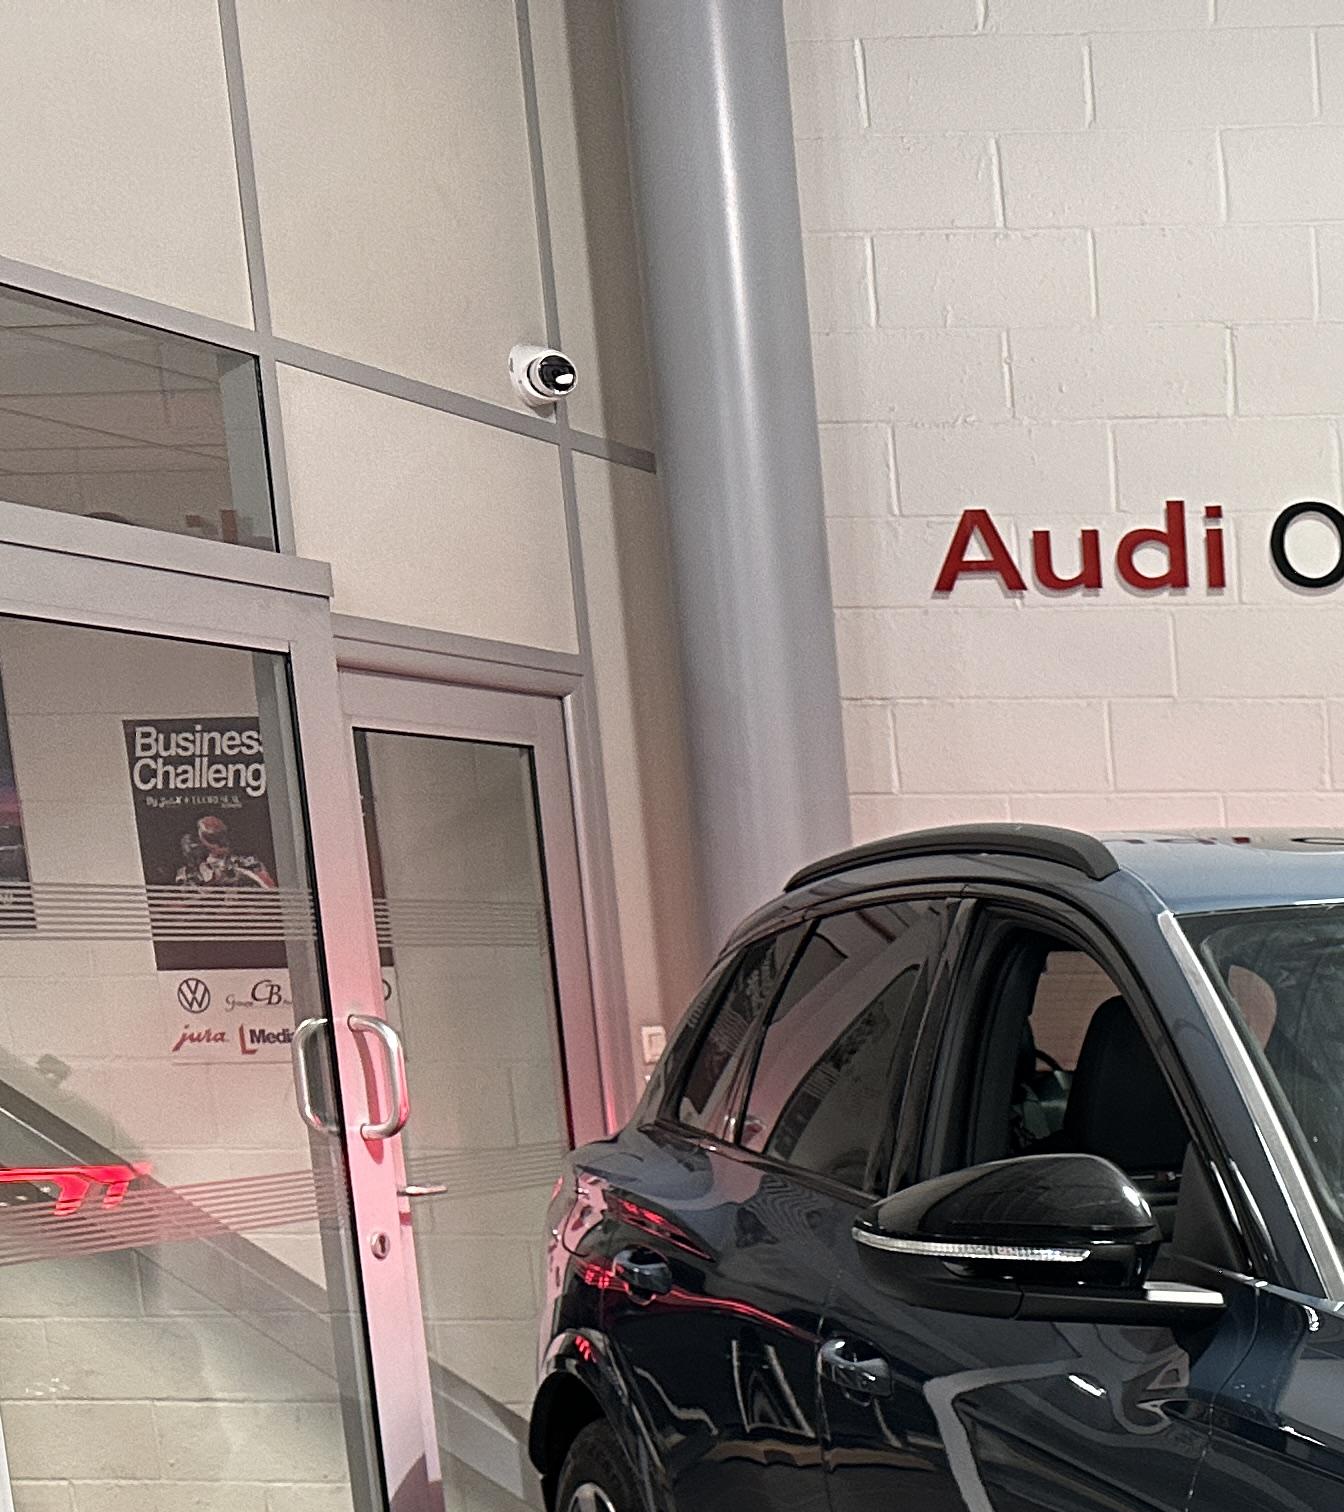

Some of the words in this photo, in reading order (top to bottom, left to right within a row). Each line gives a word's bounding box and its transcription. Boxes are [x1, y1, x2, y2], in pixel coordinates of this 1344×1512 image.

[935, 501, 1226, 592] Audi
[134, 724, 264, 757] Busines
[172, 1024, 227, 1052] jura
[250, 1028, 295, 1044] Medi
